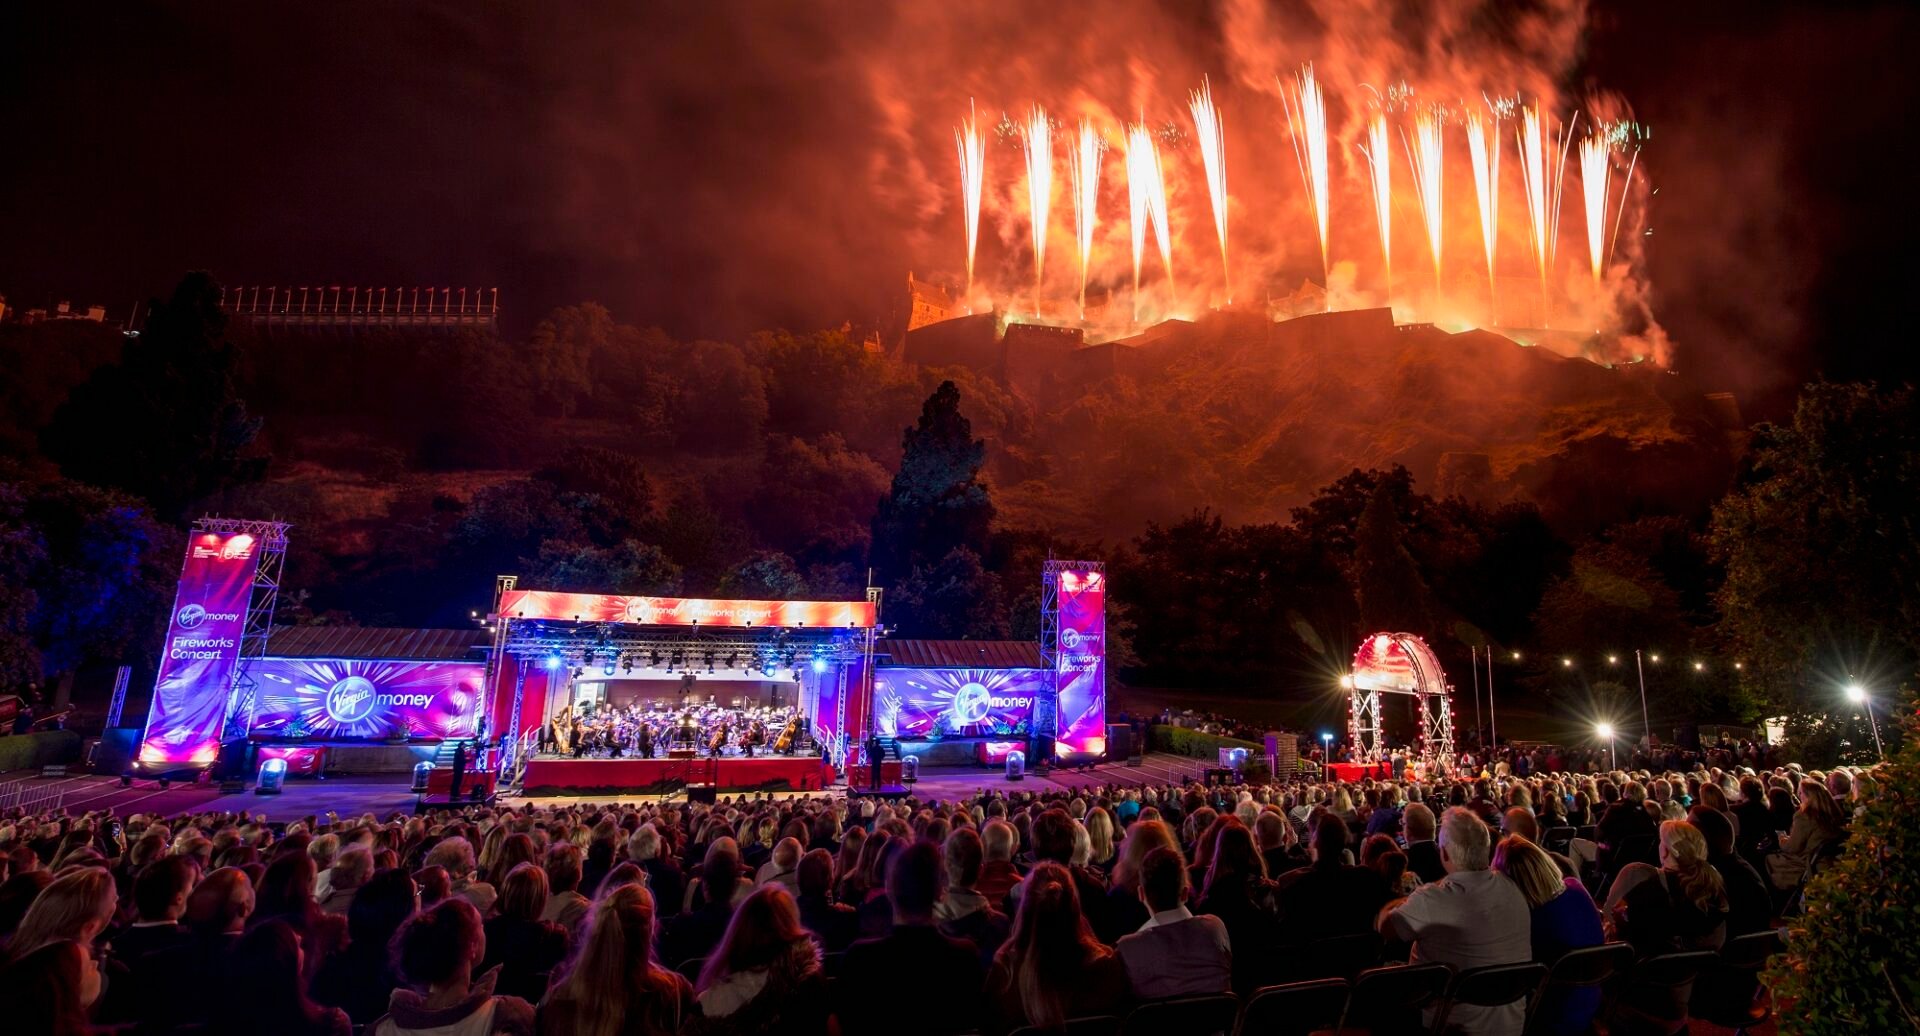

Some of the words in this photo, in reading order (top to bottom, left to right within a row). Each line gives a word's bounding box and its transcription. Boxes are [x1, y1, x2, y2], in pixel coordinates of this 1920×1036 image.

[181, 607, 203, 625] Virgin
[205, 613, 239, 622] money
[736, 608, 772, 618] Concert
[173, 636, 234, 648] Fireworks
[171, 648, 222, 660] Concert
[1062, 654, 1101, 662] Fireworks
[332, 682, 371, 714] Virgin
[377, 694, 434, 710] money
[991, 697, 1032, 710] money
